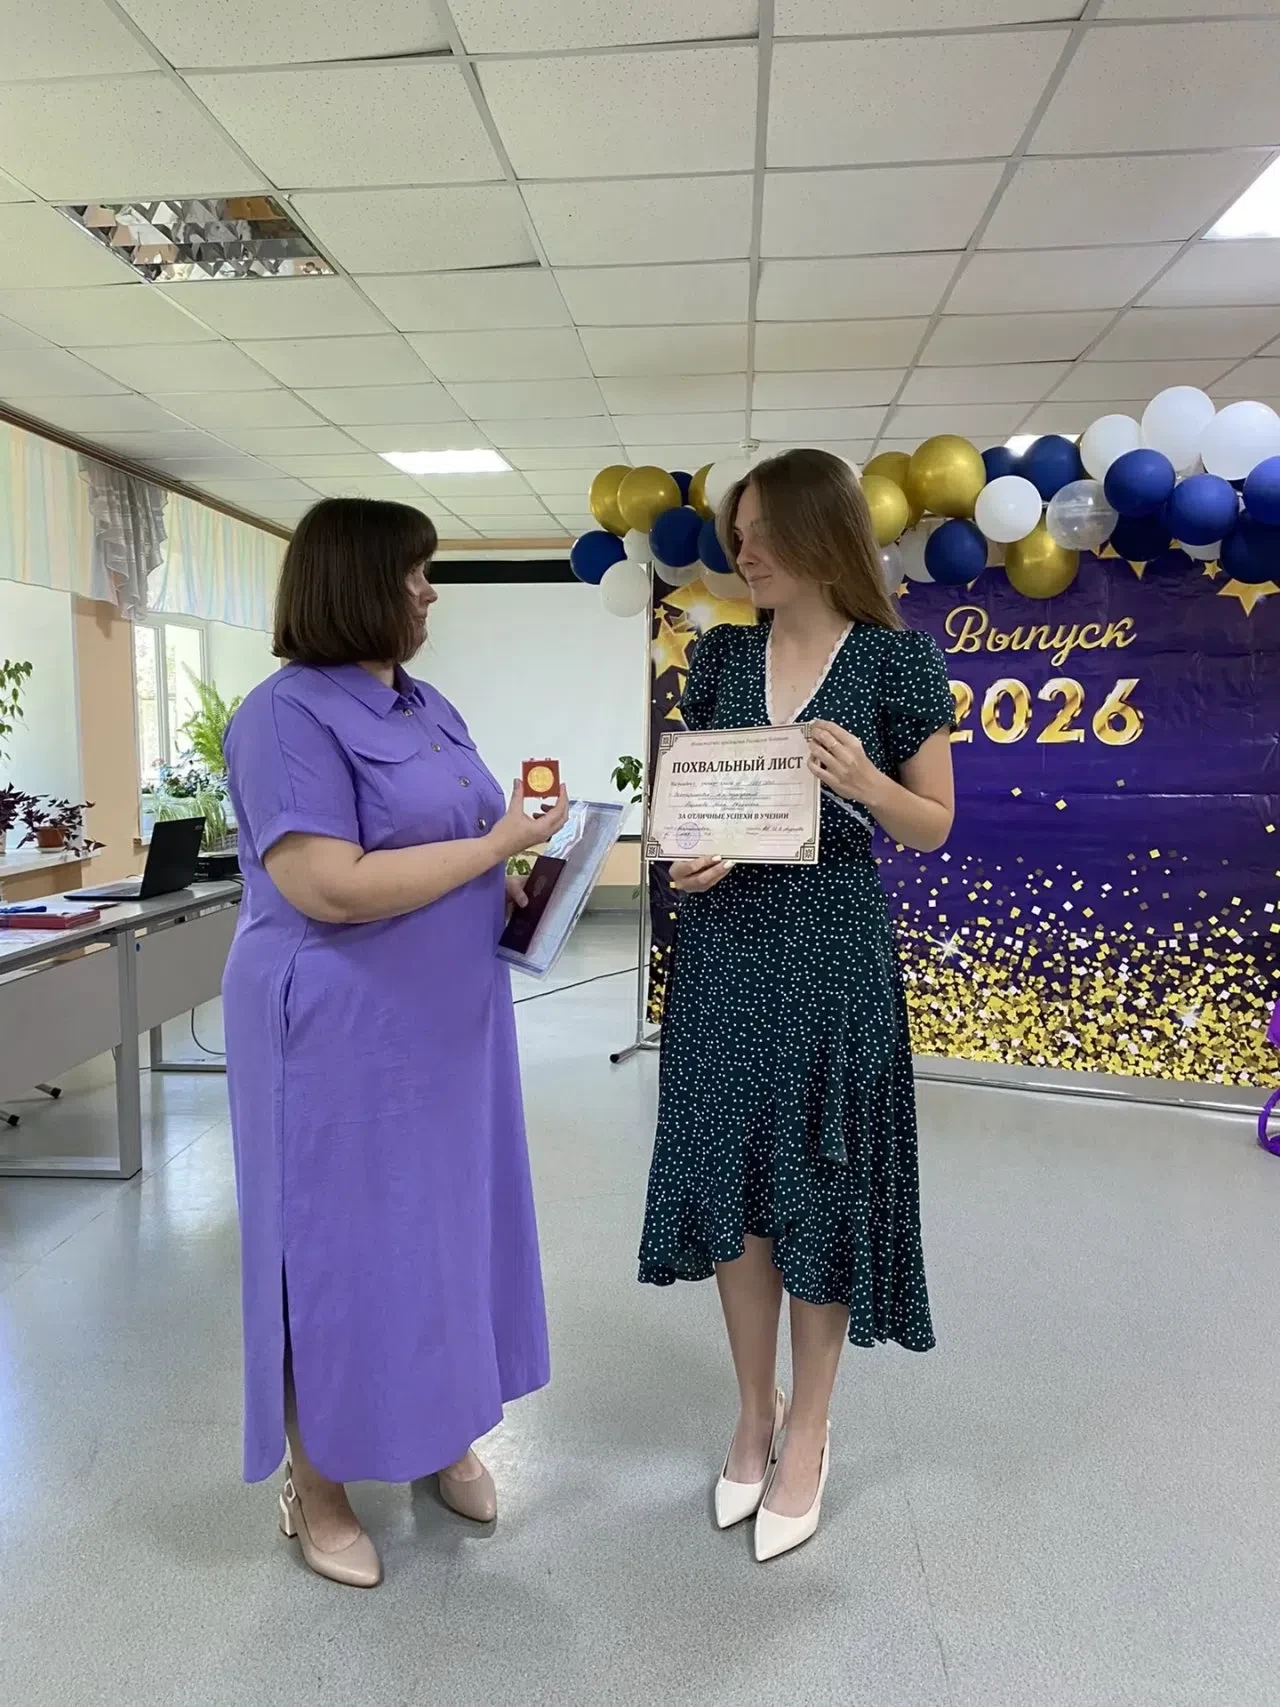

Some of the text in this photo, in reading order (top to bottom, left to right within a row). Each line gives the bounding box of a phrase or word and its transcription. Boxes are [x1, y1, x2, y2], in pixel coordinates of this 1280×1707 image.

[944, 605, 1138, 667] Выпуск
[949, 677, 1145, 746] 2026
[672, 756, 804, 773] ПОХВАЛЬНЫЙ ЛИСТ
[726, 812, 753, 820] УСПЕХИ
[760, 812, 789, 820] УЧЕНИИ
